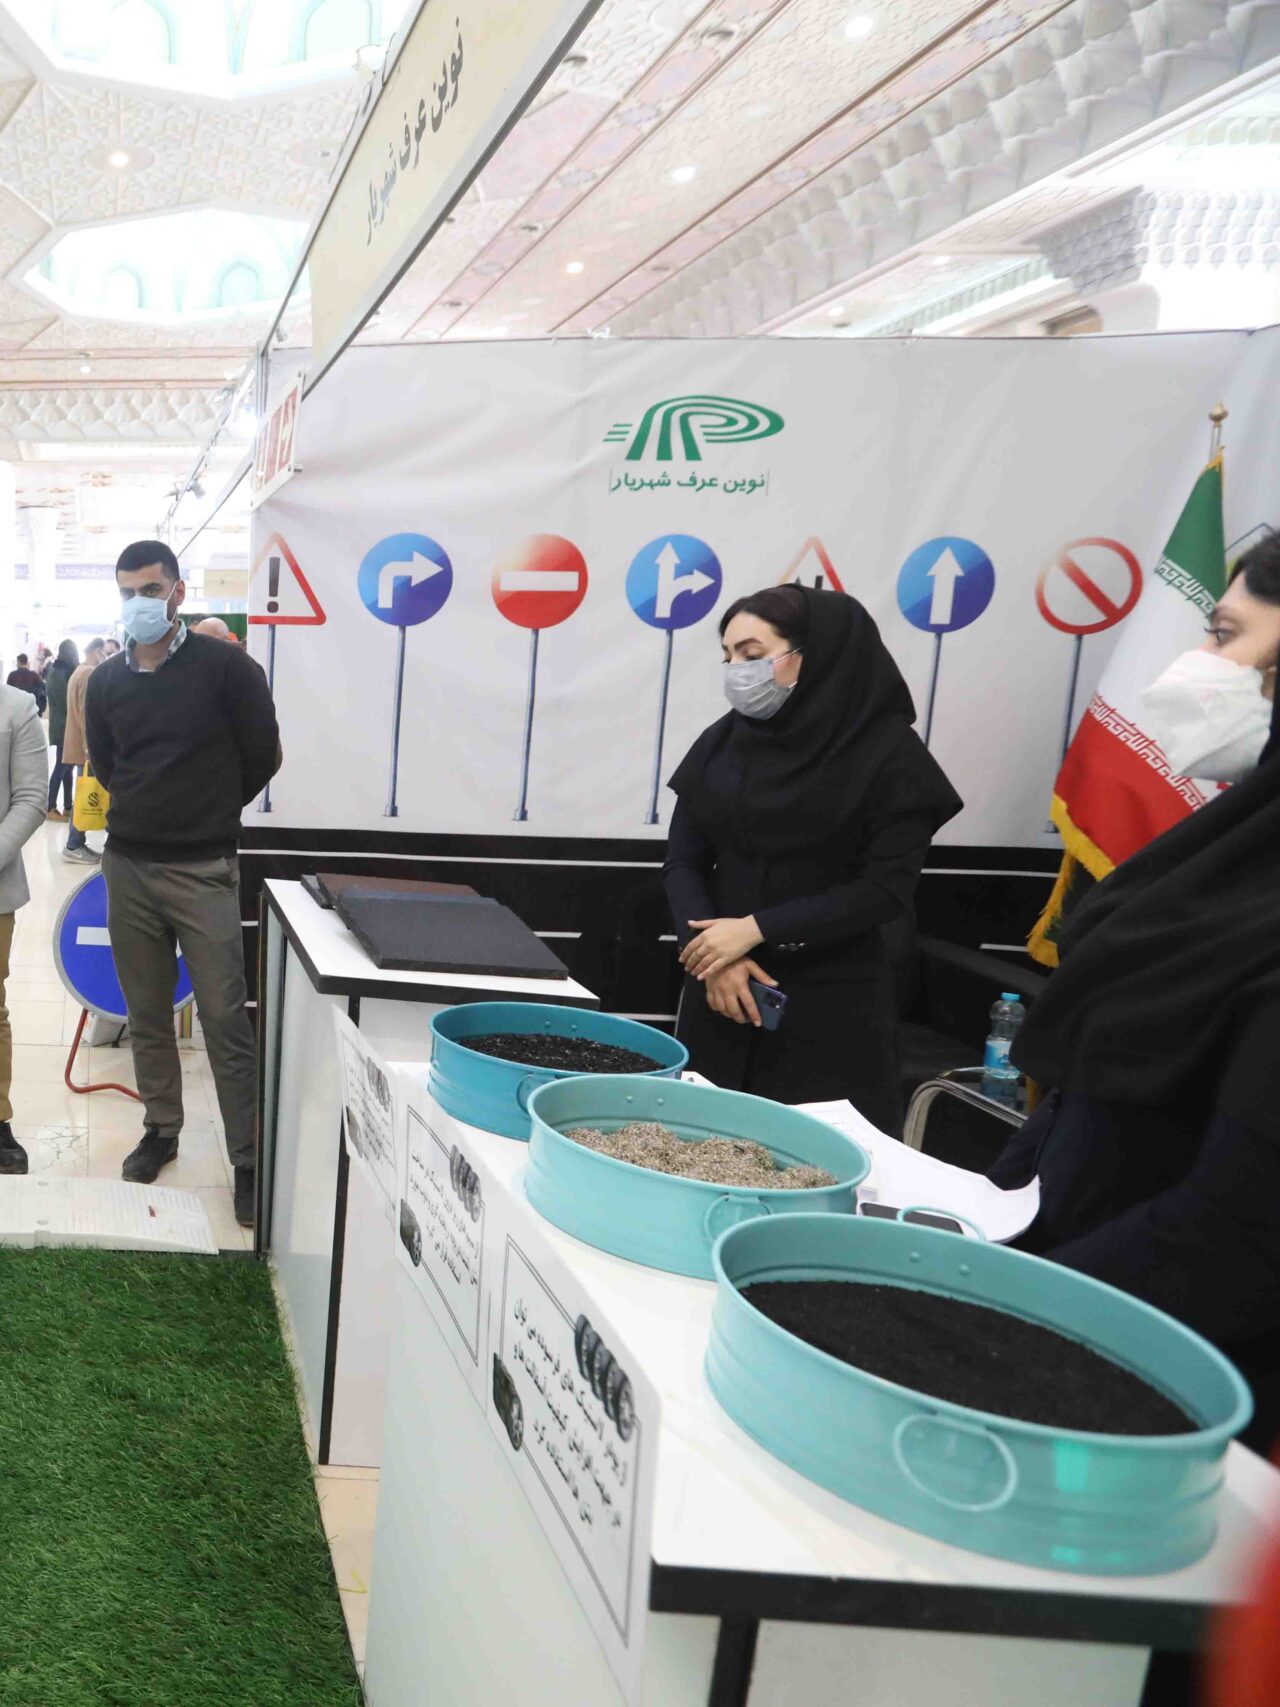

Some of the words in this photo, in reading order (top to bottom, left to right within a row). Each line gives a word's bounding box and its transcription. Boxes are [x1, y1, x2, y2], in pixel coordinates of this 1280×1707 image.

[431, 16, 463, 133] نوین
[400, 98, 427, 169] عرف
[367, 141, 397, 246] شهریار
[611, 471, 672, 492] شهریار
[677, 471, 718, 492] عرف
[723, 474, 766, 495] نوین
[514, 1298, 527, 1327] توان
[537, 1333, 560, 1376] فرسوده
[560, 1369, 576, 1399] های
[533, 1419, 546, 1445] کرد
[546, 1392, 568, 1433] کیفیت
[576, 1390, 604, 1441] لاستیک
[546, 1441, 571, 1487] استفاده
